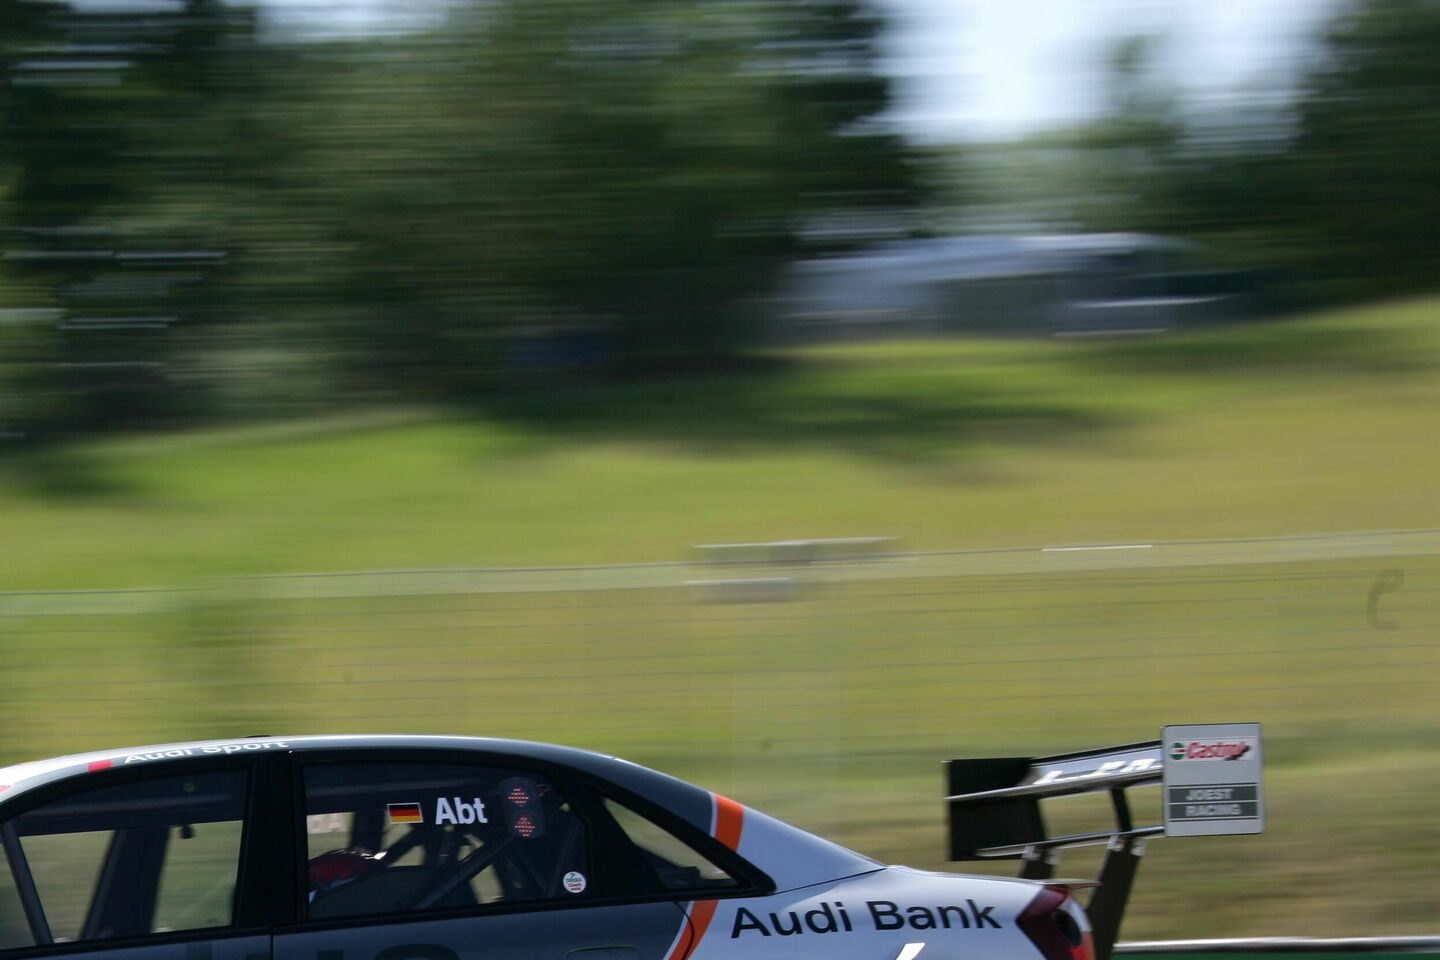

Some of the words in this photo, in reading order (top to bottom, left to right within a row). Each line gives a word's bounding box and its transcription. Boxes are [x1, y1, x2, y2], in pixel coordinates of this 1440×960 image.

[124, 749, 194, 764] Audi
[199, 741, 290, 755] Sport
[1185, 788, 1234, 801] JOEST
[434, 797, 489, 825] Abt
[1185, 803, 1242, 817] RACING
[730, 901, 853, 939] Audi
[865, 898, 1002, 931] Bank
